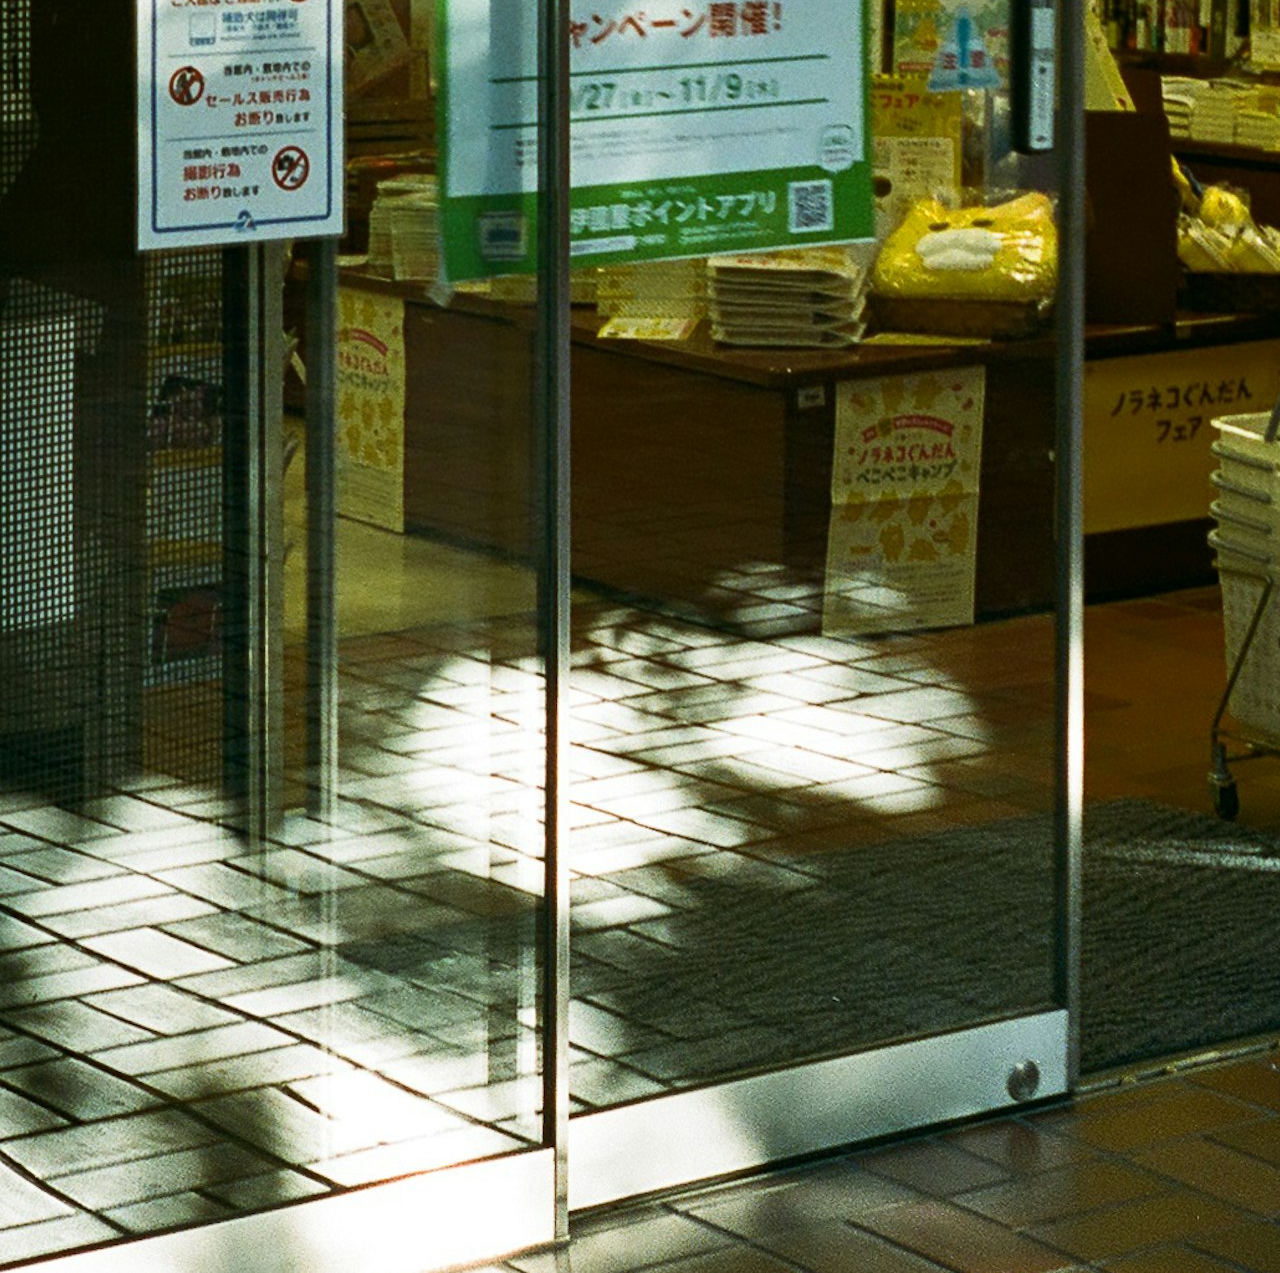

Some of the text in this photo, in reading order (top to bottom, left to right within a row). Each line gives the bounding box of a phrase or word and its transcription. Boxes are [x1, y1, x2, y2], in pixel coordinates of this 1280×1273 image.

[206, 88, 311, 108] セールス販売行為
[234, 111, 311, 127] お断り致します
[183, 162, 242, 182] 撮影行為
[183, 185, 260, 202] お断り致します
[1111, 378, 1253, 416] ノラネコぐんだん
[1157, 415, 1203, 443] フェア
[858, 442, 956, 466] ノラネコぐんだん
